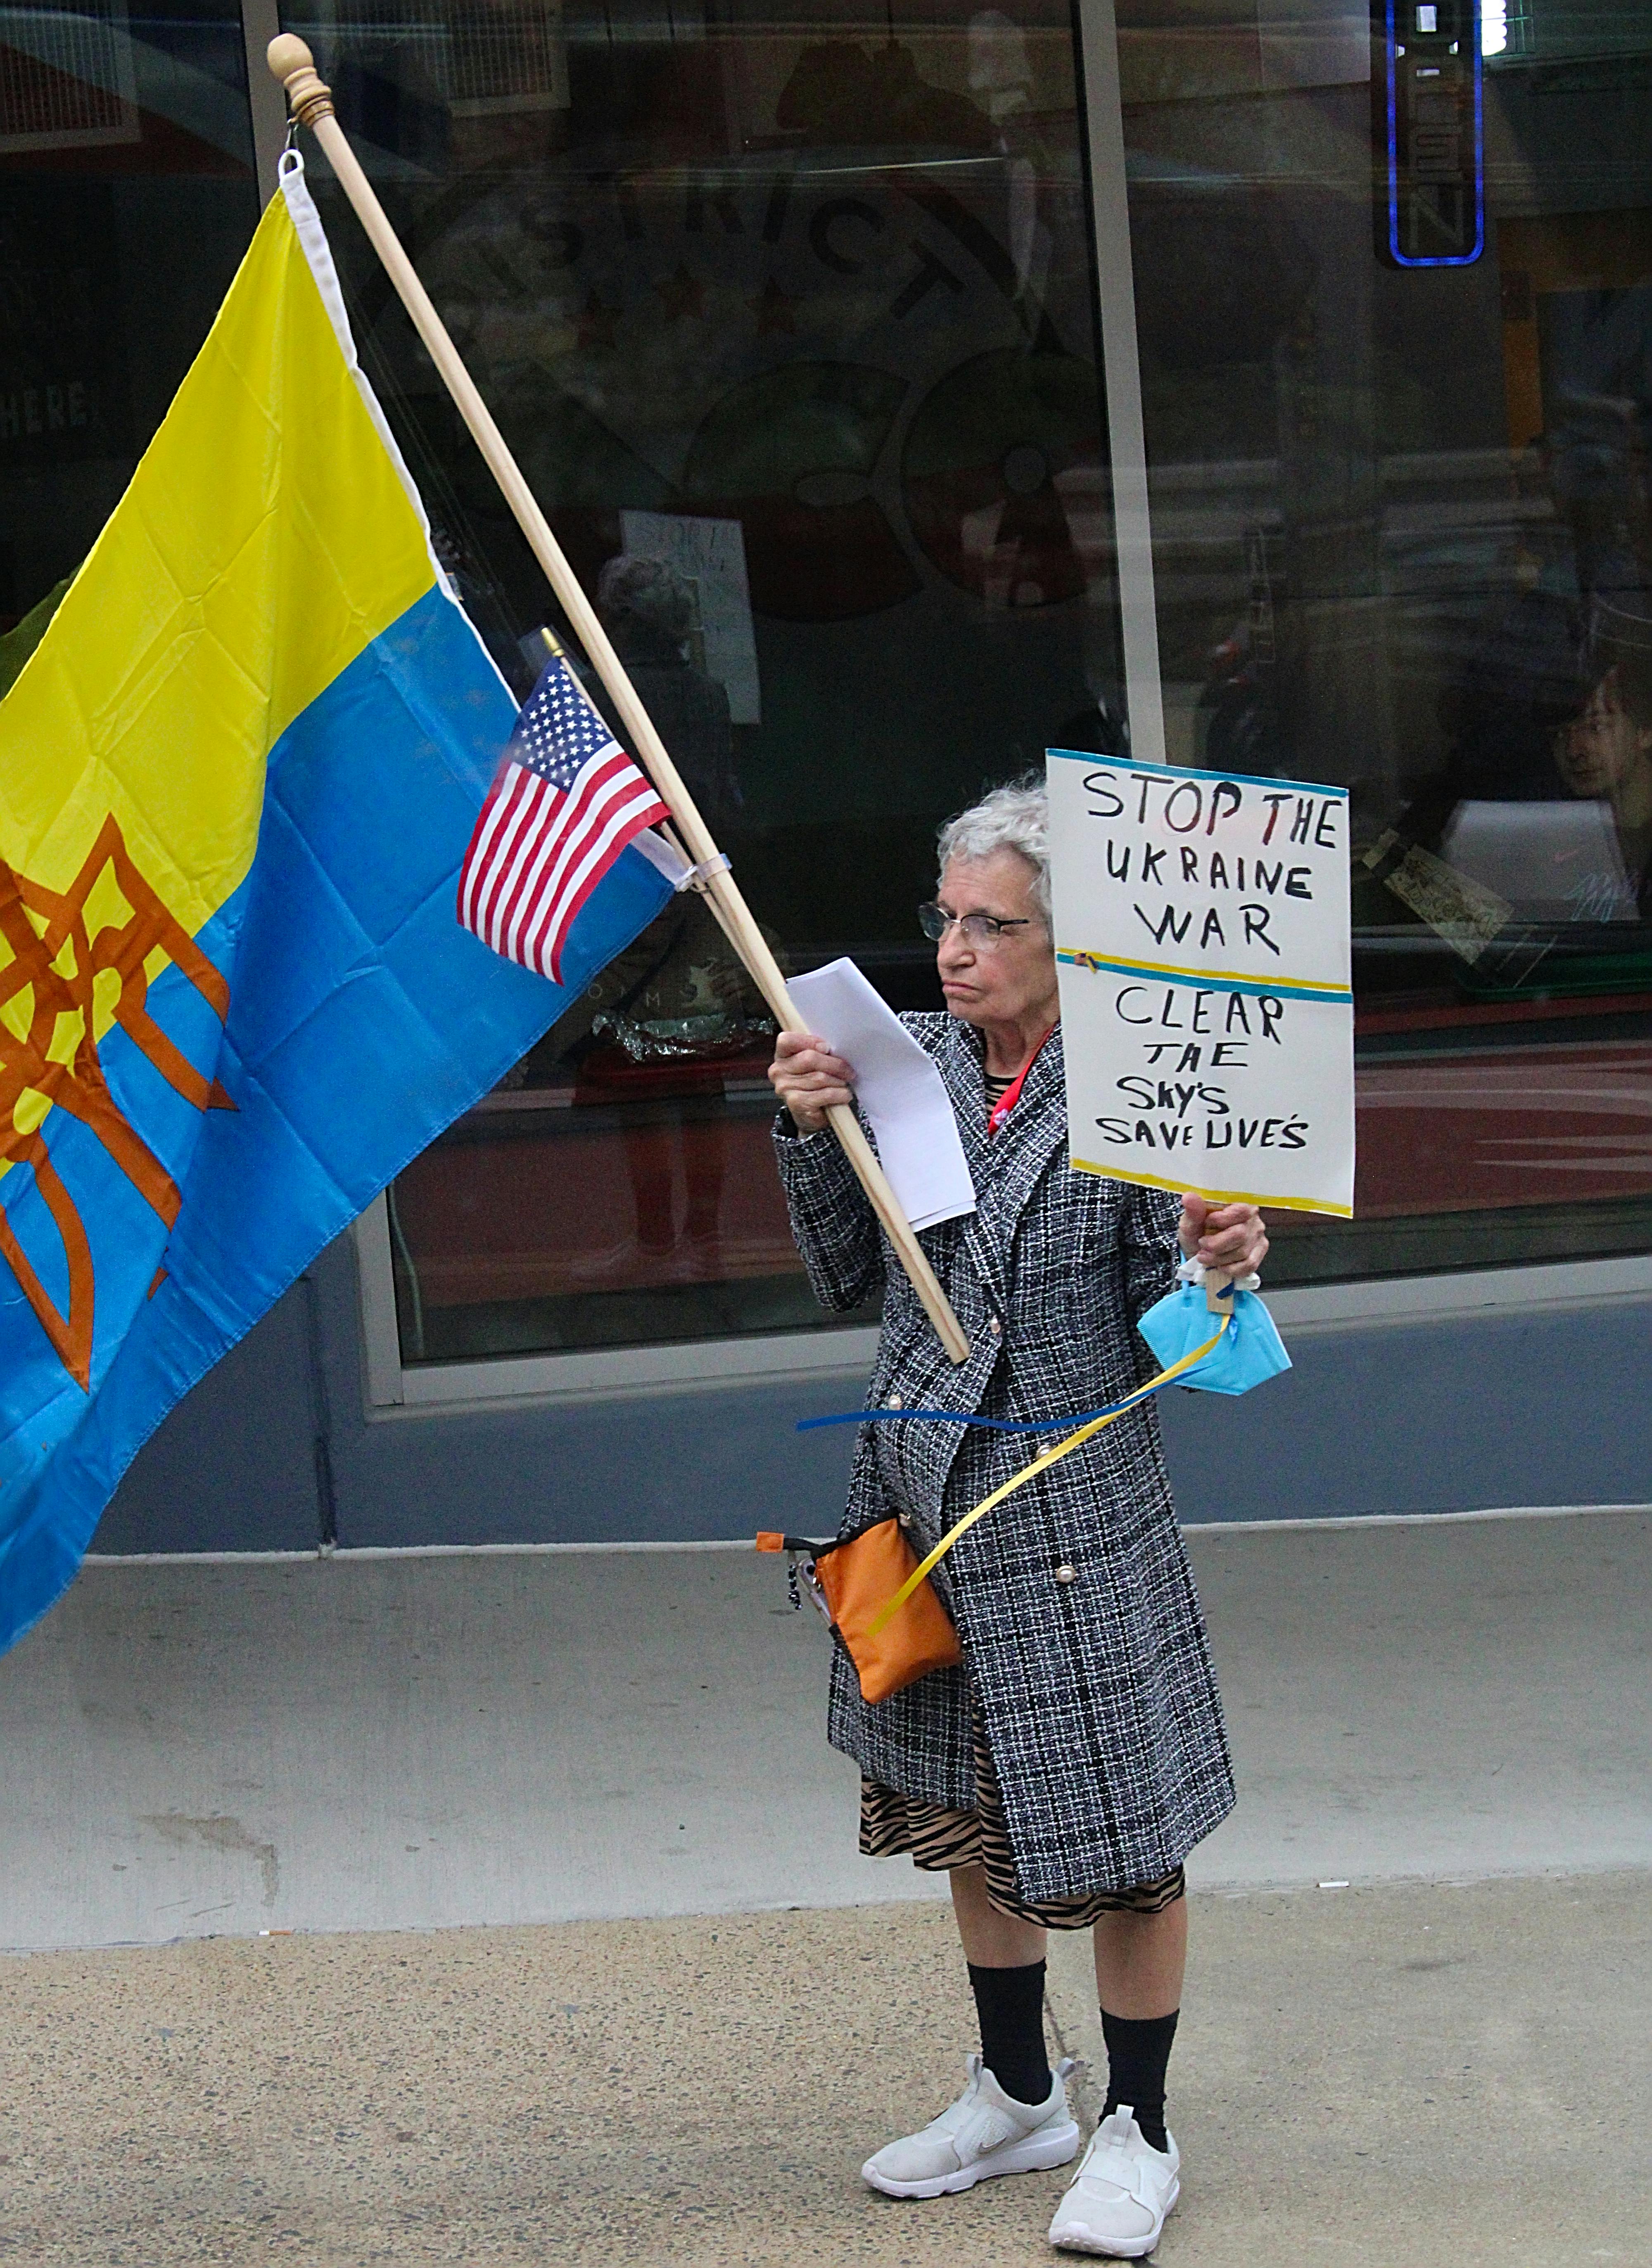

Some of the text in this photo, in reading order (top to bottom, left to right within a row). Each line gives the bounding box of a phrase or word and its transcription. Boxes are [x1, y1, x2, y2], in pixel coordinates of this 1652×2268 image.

[1082, 771, 1343, 849] STOP THE
[1107, 839, 1313, 901] UKRAINE
[1132, 903, 1281, 957] WAR
[1116, 986, 1284, 1045] CLEAR
[1143, 1042, 1249, 1073] THE
[1095, 1117, 1194, 1151] SAVE
